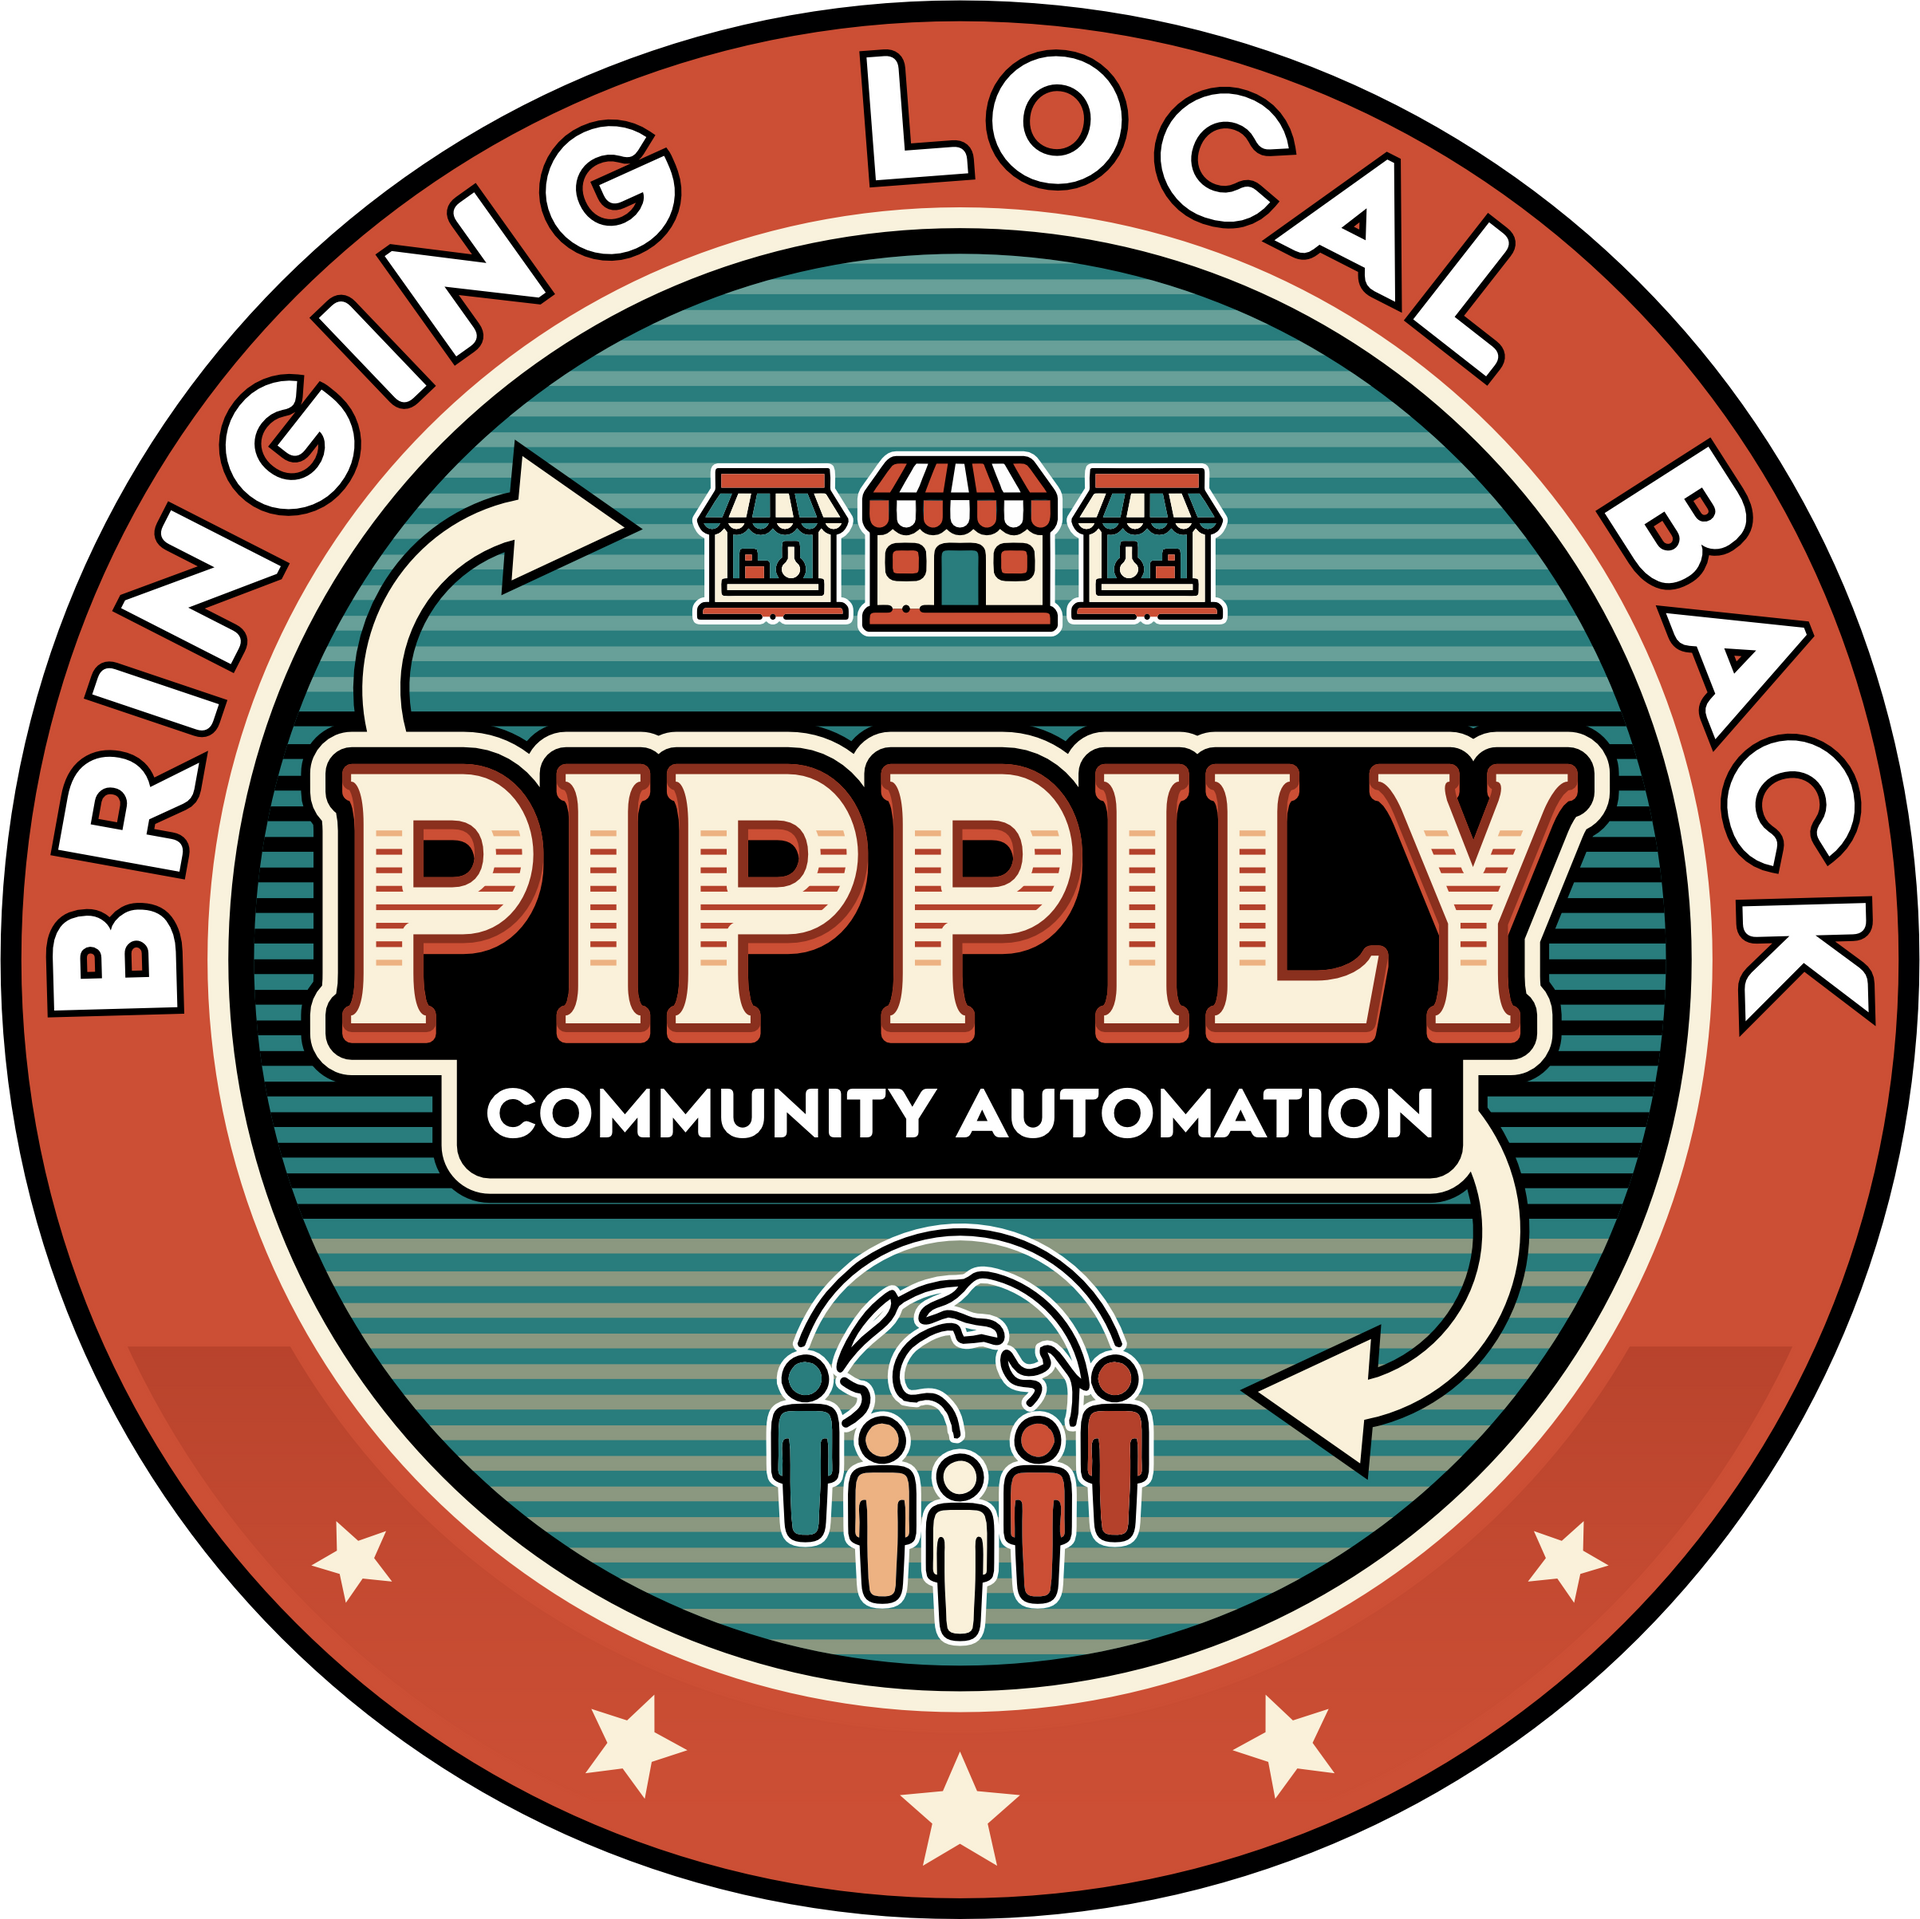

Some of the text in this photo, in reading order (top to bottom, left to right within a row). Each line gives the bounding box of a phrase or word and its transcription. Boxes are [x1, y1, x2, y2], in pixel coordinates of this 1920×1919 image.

[47, 50, 1875, 1033] BRINGING LOCAL BACK
[342, 763, 1578, 1043] PIPPILY
[487, 1087, 1432, 1139] COMMUNITY AUTOMATION
